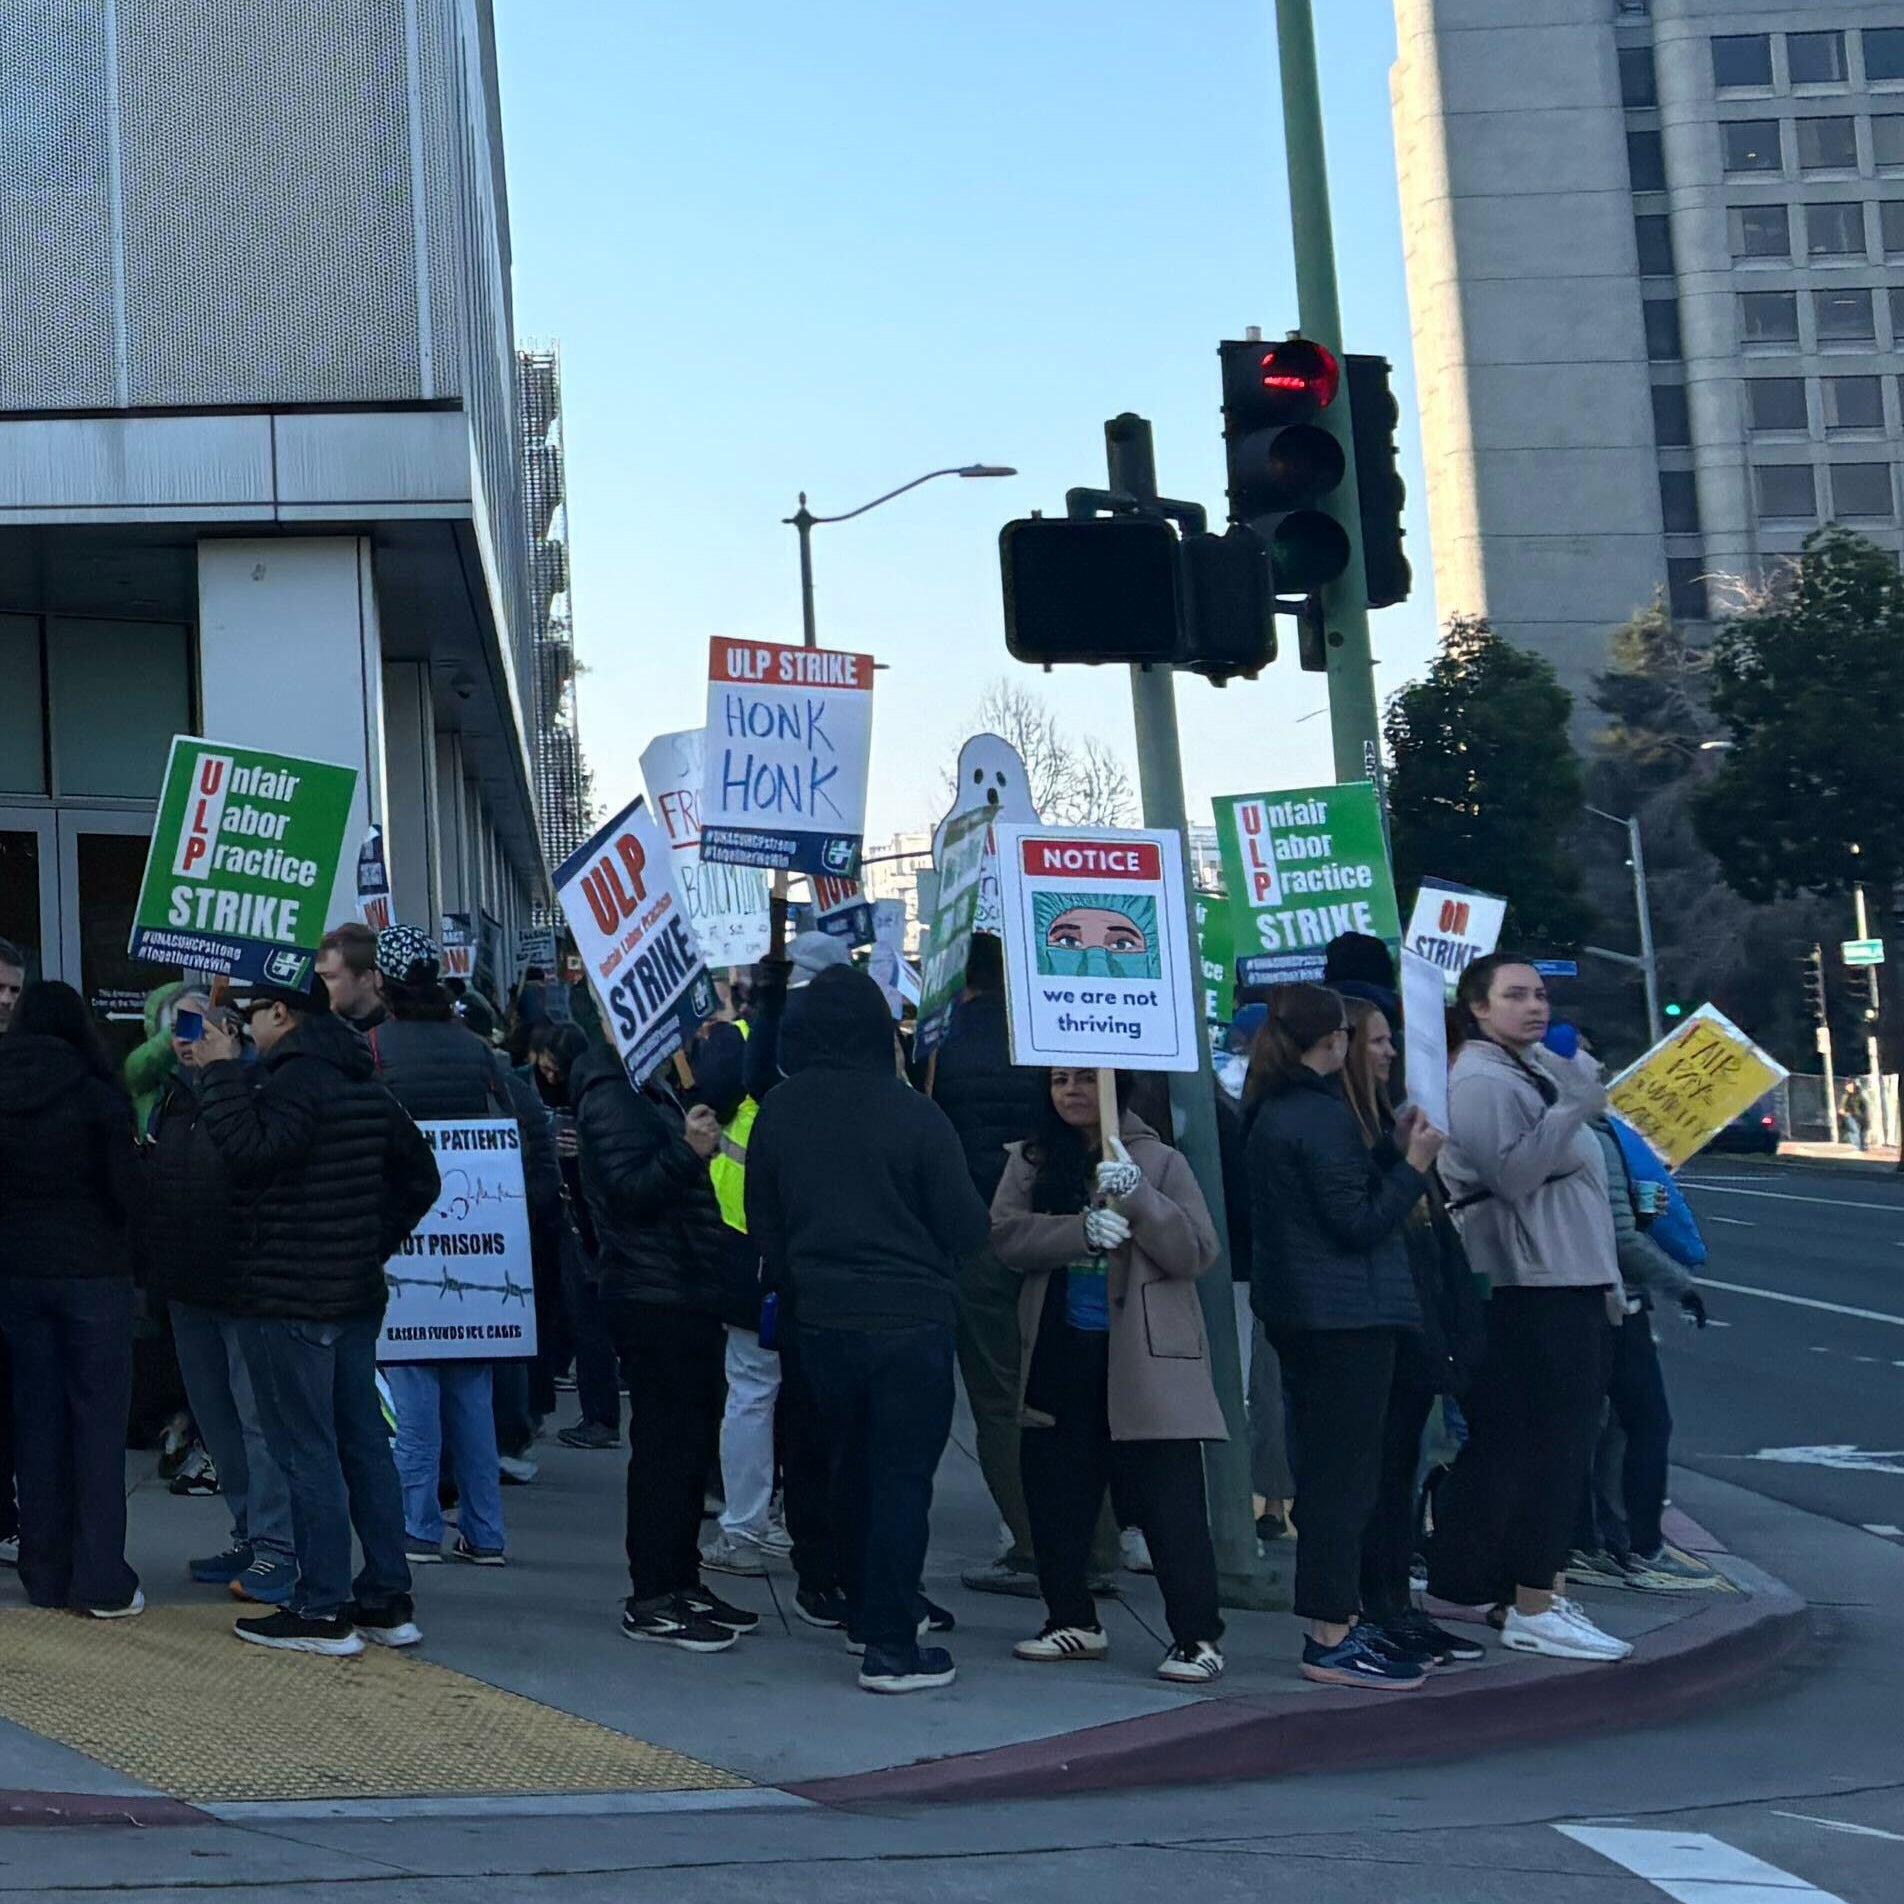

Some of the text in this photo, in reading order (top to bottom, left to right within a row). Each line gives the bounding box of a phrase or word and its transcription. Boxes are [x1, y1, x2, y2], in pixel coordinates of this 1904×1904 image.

[727, 647, 858, 685] ULP STRIKE
[726, 693, 834, 752] HONK
[722, 748, 843, 820] HONK
[1043, 848, 1140, 871] NOTICE
[581, 833, 646, 936] ULP
[168, 885, 300, 942] STRIKE
[1256, 900, 1376, 950] STRIKE
[1438, 899, 1470, 936] ON
[610, 914, 697, 1041] STRIKE
[1043, 990, 1158, 1006] we are not
[1058, 1013, 1141, 1039] thriving
[442, 1129, 518, 1150] PATIENTS
[429, 1233, 505, 1255] PRISONS
